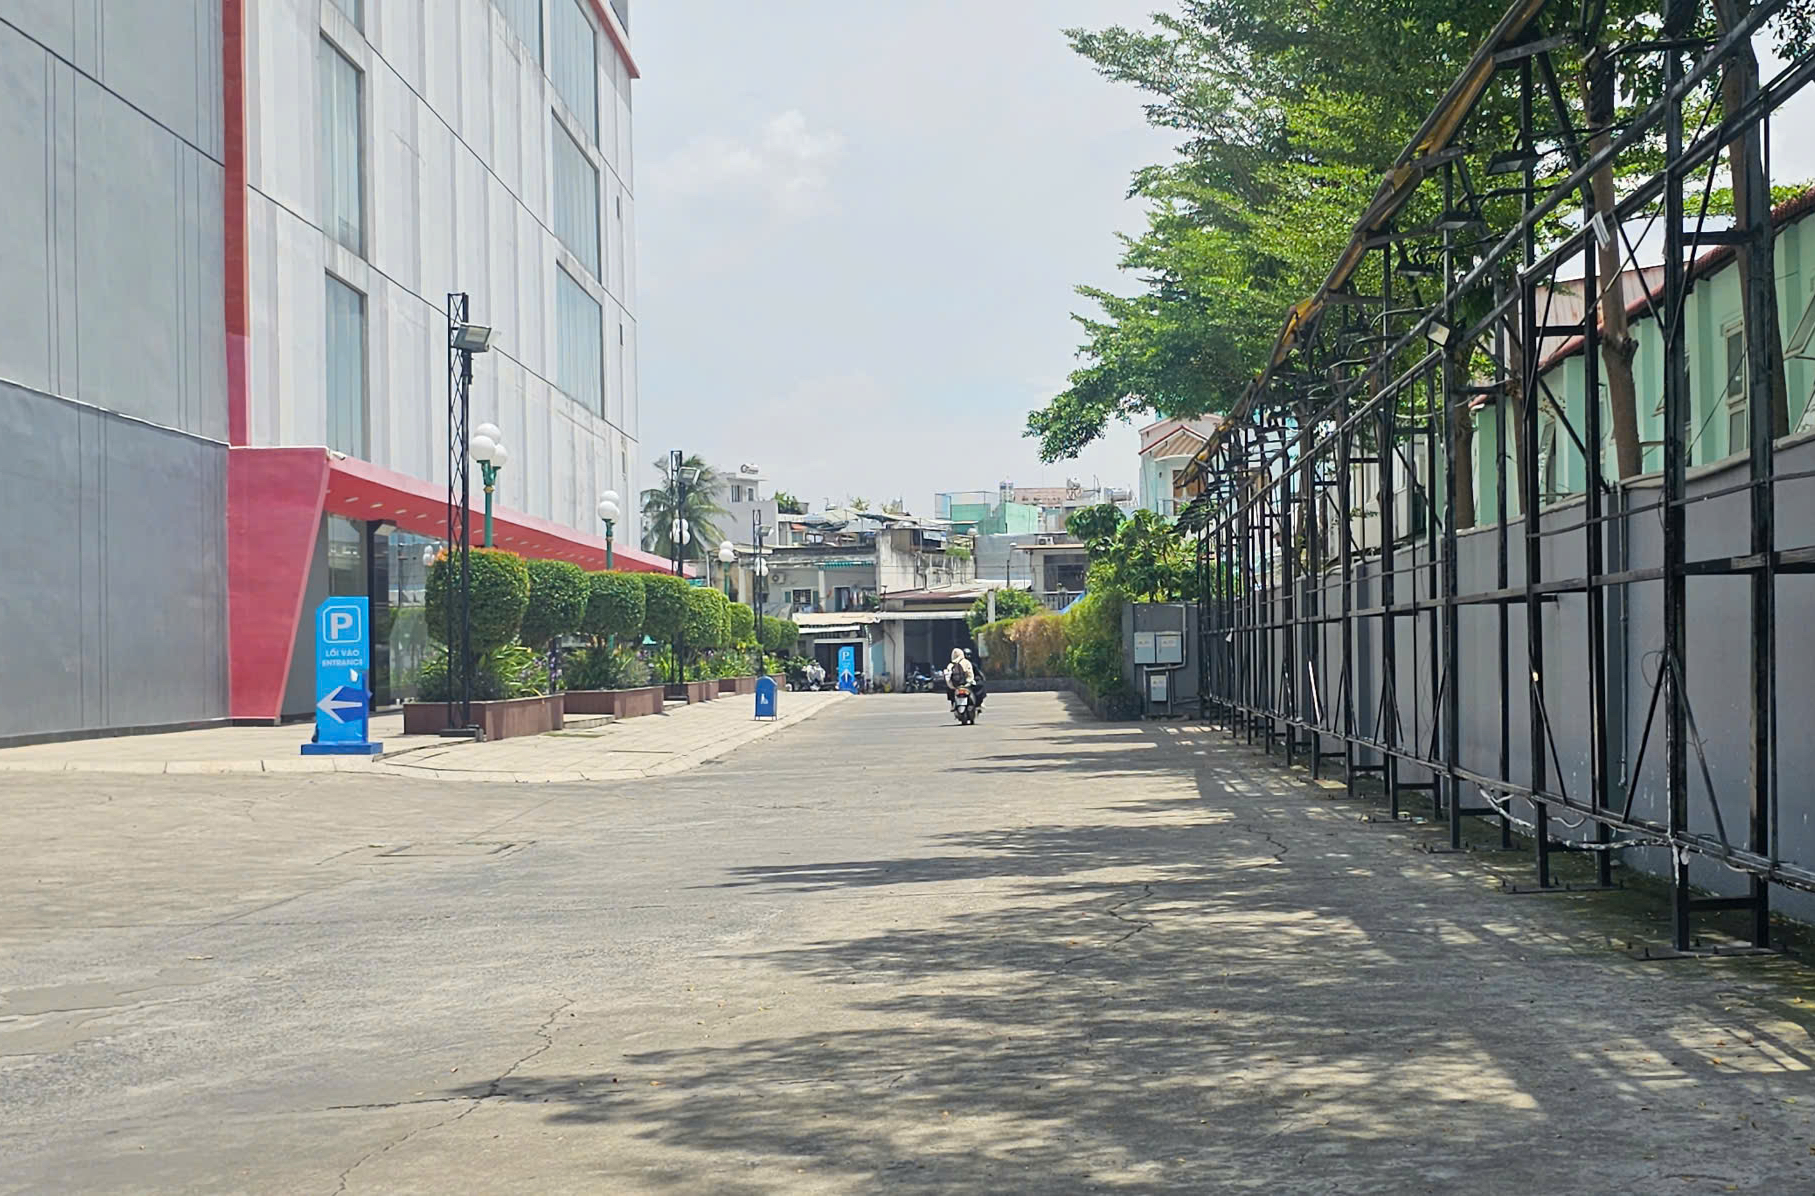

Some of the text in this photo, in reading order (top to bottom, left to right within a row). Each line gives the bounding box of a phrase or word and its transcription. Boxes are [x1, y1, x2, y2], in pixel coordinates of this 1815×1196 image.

[331, 612, 353, 640] P
[842, 651, 850, 660] P
[322, 659, 362, 667] ENTRANCE
